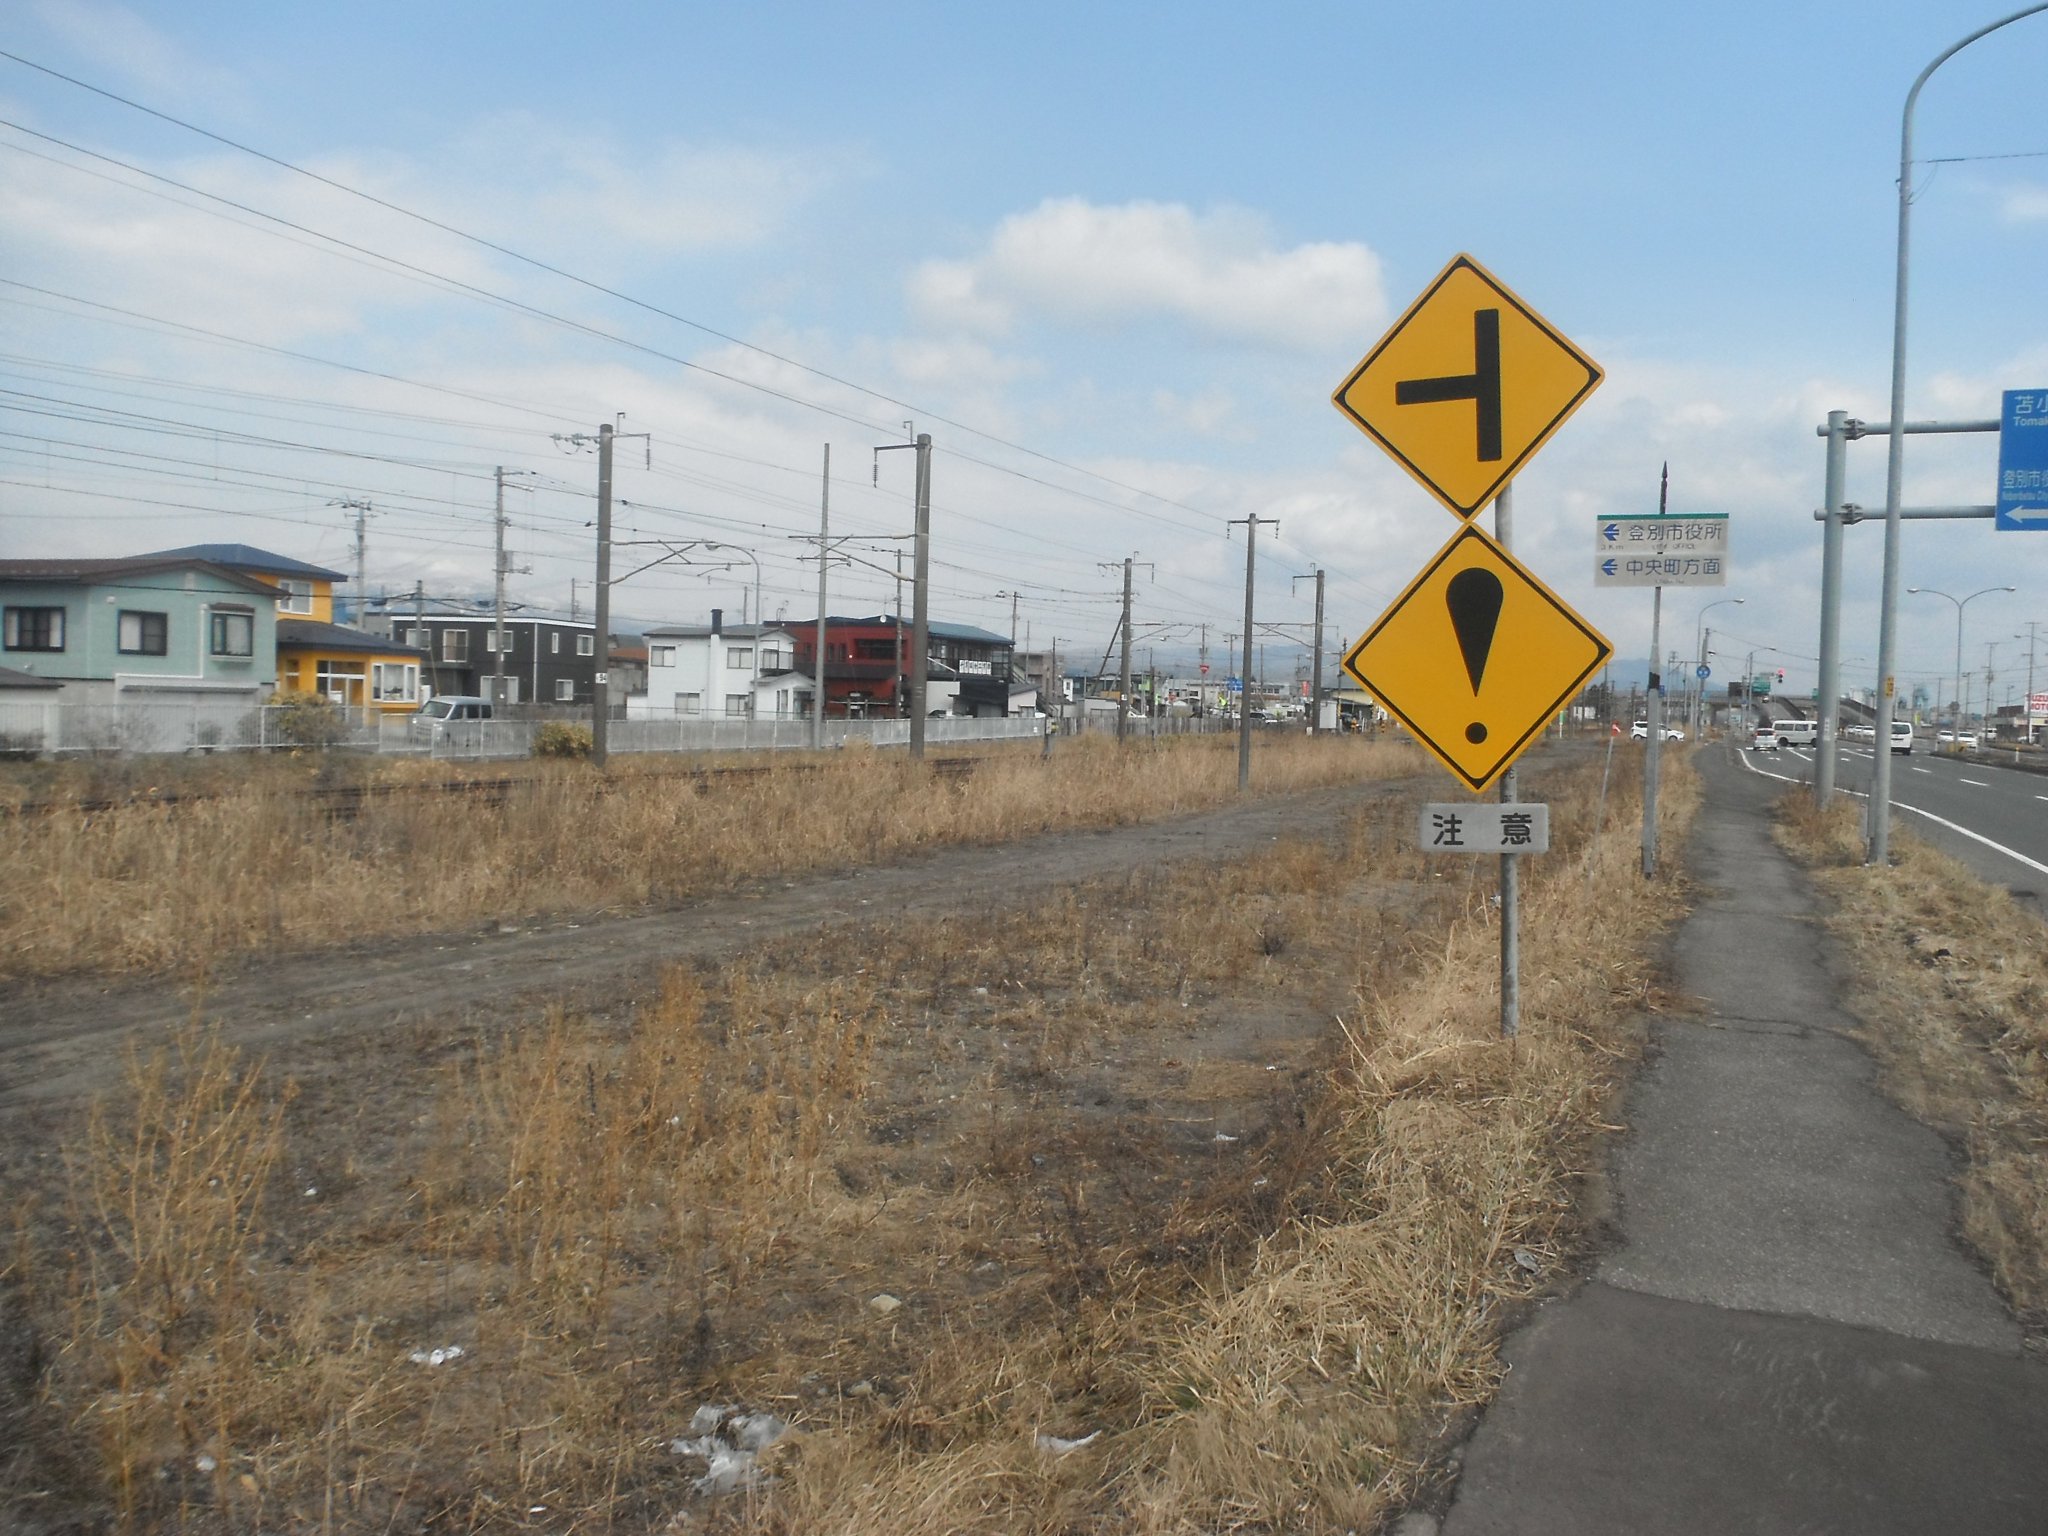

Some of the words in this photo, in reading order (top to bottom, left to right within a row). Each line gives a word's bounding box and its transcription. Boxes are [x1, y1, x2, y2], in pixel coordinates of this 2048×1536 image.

[1628, 522, 1722, 541] 登別市役所
[1626, 558, 1720, 576] 中央町方面
[1432, 813, 1532, 845] 注意
